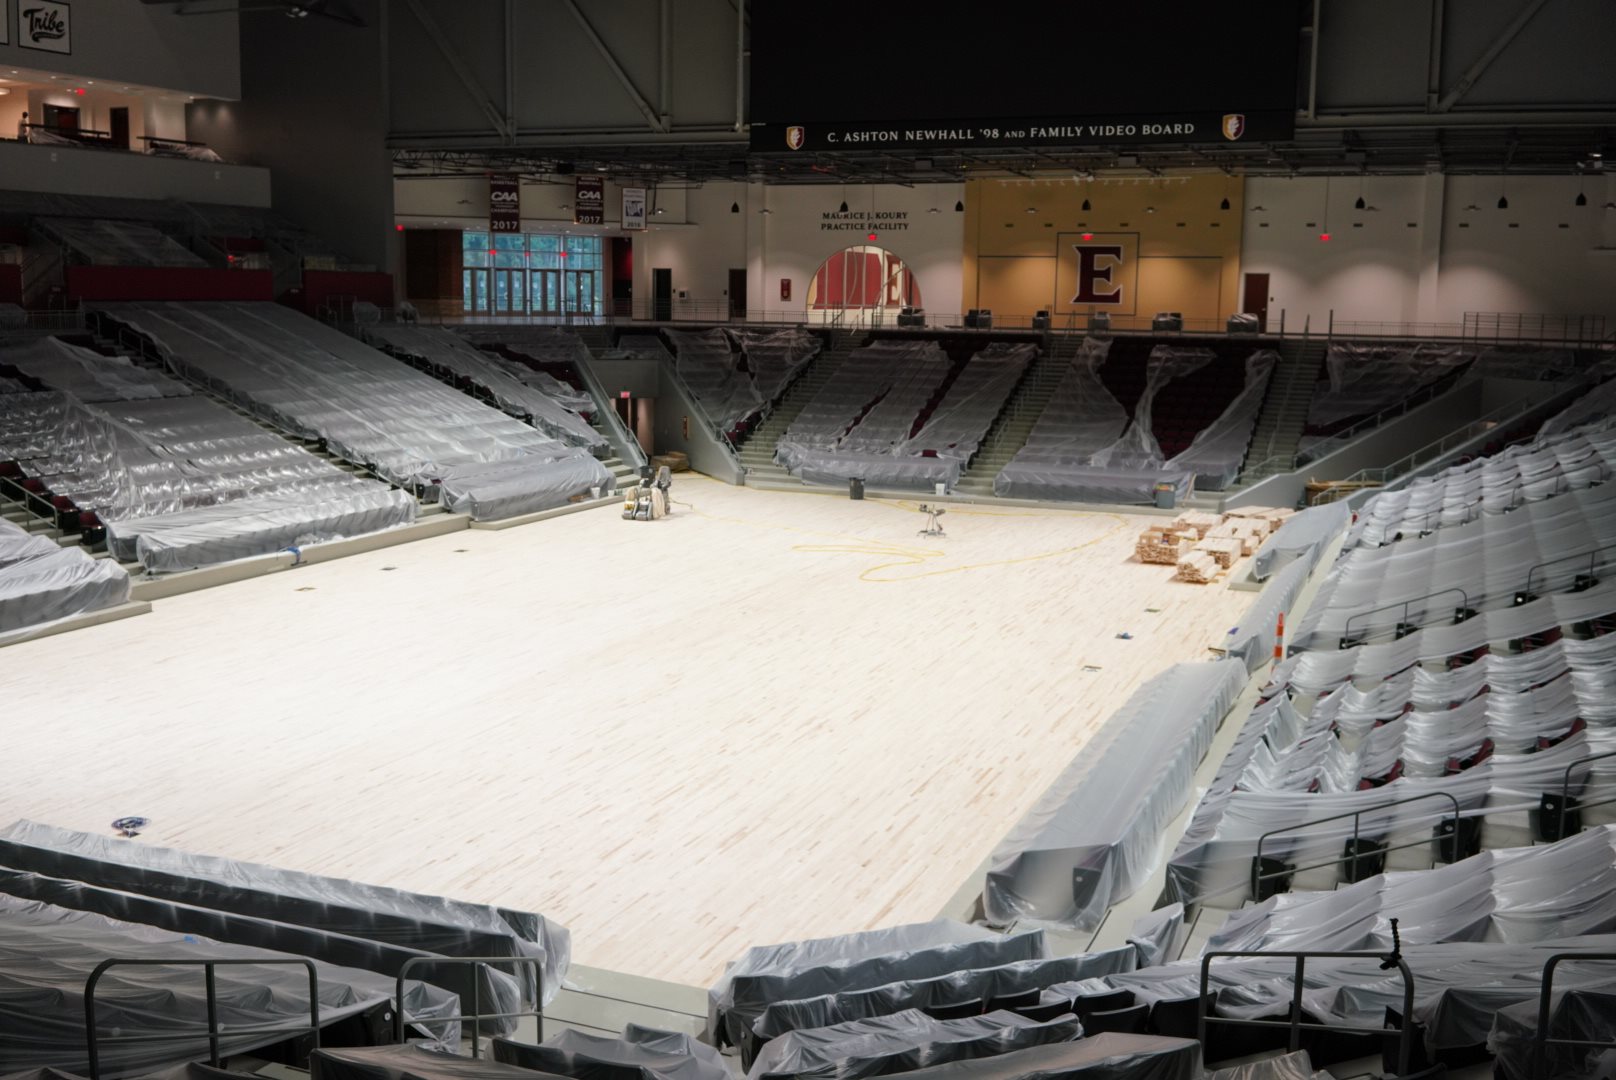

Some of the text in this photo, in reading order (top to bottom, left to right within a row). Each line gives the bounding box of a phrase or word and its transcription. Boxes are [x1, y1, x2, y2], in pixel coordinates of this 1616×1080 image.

[23, 7, 65, 36] Tribe
[827, 123, 1195, 143] C. ASHTON NEWHALL '98 AND FAMILY VIDEO BOARD
[491, 191, 518, 201] CAA
[578, 190, 601, 200] CAA
[579, 215, 600, 224] 2017
[822, 212, 865, 220] MAURICE
[875, 212, 908, 220] KOURY
[492, 221, 518, 230] 2017
[821, 222, 909, 230] PRACTICE FACILITY
[1070, 245, 1123, 304] E
